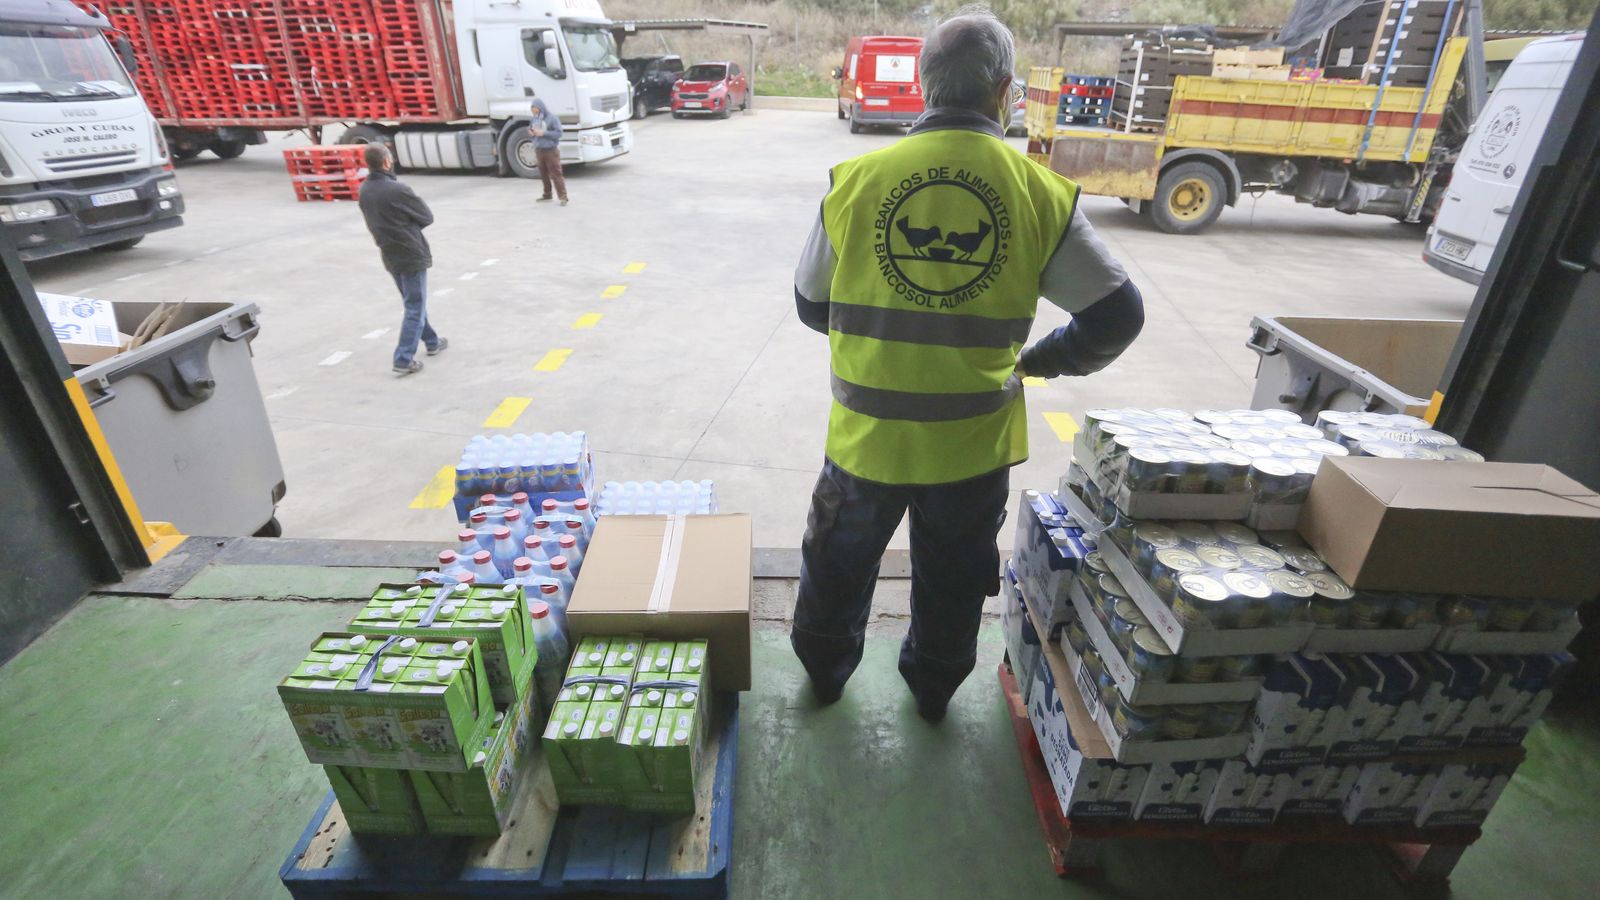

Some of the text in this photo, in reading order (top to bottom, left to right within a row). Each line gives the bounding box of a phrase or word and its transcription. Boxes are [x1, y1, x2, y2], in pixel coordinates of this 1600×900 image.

[62, 108, 97, 117] IVECO
[31, 126, 75, 138] GRUA
[43, 143, 137, 157] EUROCARGO
[875, 166, 1012, 245] BANCOS DE ALIMENTOS
[874, 242, 935, 308] BANCOSOL
[1050, 733, 1073, 787] DESNATADA
